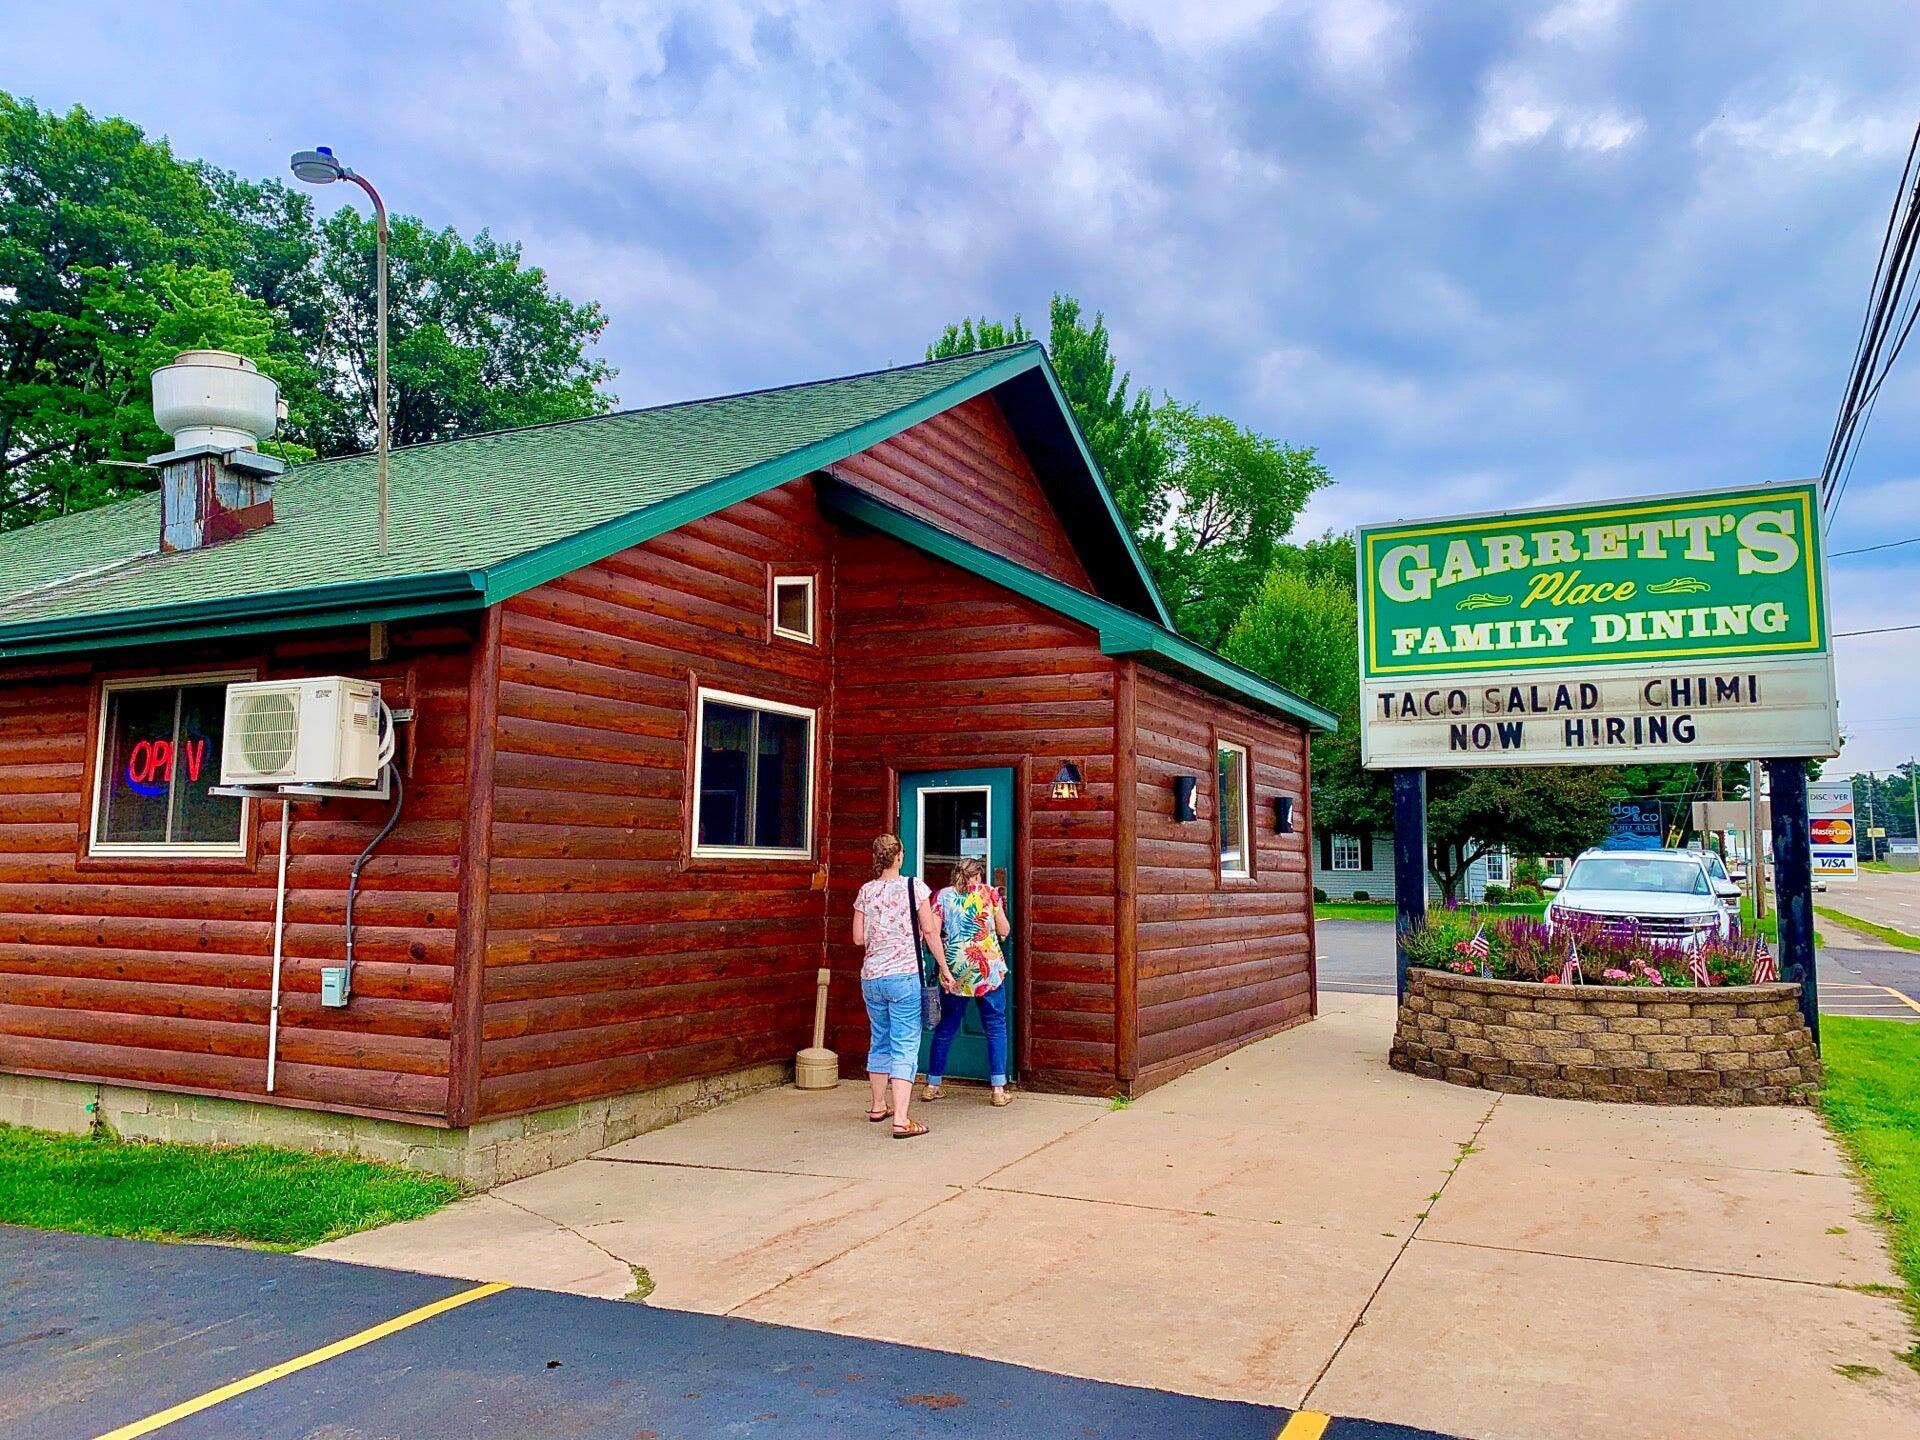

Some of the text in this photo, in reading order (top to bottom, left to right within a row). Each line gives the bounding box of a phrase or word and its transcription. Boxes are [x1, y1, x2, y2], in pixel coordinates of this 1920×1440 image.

[1378, 509, 1800, 603] GARRETT'S
[1519, 570, 1638, 609] Place
[1391, 602, 1790, 656] FAMILY DINING
[1378, 674, 1757, 719] TACO SALAD CHIMI
[1449, 721, 1524, 751] NOW
[1811, 828, 1852, 837] MasterCard
[1820, 858, 1846, 868] VISA
